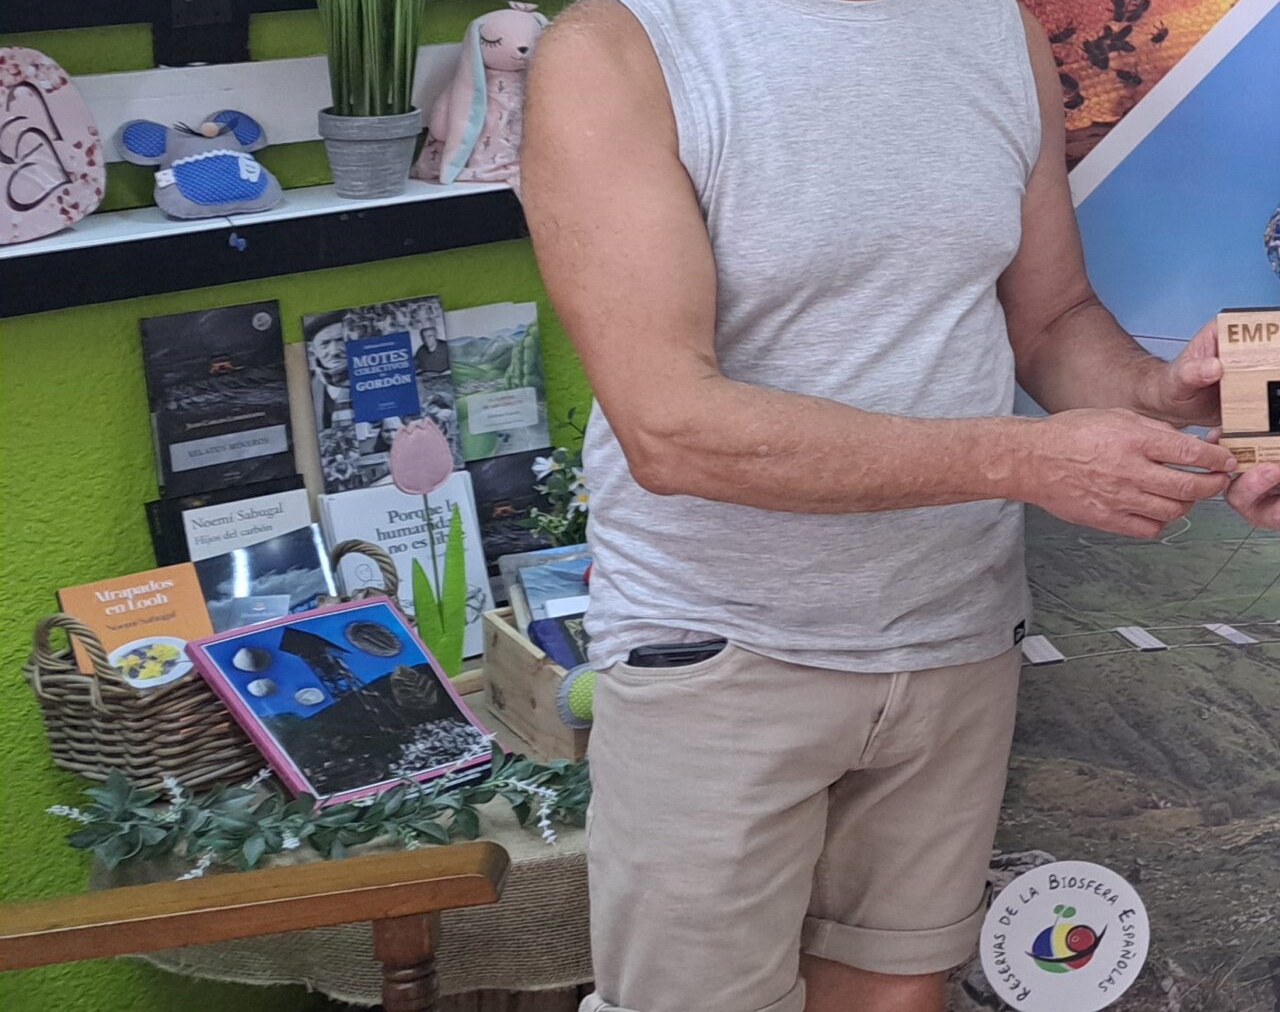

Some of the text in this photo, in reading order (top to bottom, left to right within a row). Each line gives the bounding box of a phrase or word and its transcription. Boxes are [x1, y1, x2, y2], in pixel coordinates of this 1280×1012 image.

[352, 349, 409, 368] MOTES
[354, 361, 410, 376] COLECTIVOS
[356, 373, 411, 392] GORDÓN
[191, 503, 284, 530] Noemí Sabugal
[195, 524, 273, 546] Hijos del carbón
[388, 542, 407, 555] no
[412, 538, 428, 549] es
[95, 580, 175, 602] Atrapados
[105, 602, 125, 616] en
[993, 873, 1137, 1001] RESERVAS DE LA BIOSFERA ESPAÑOLAS
